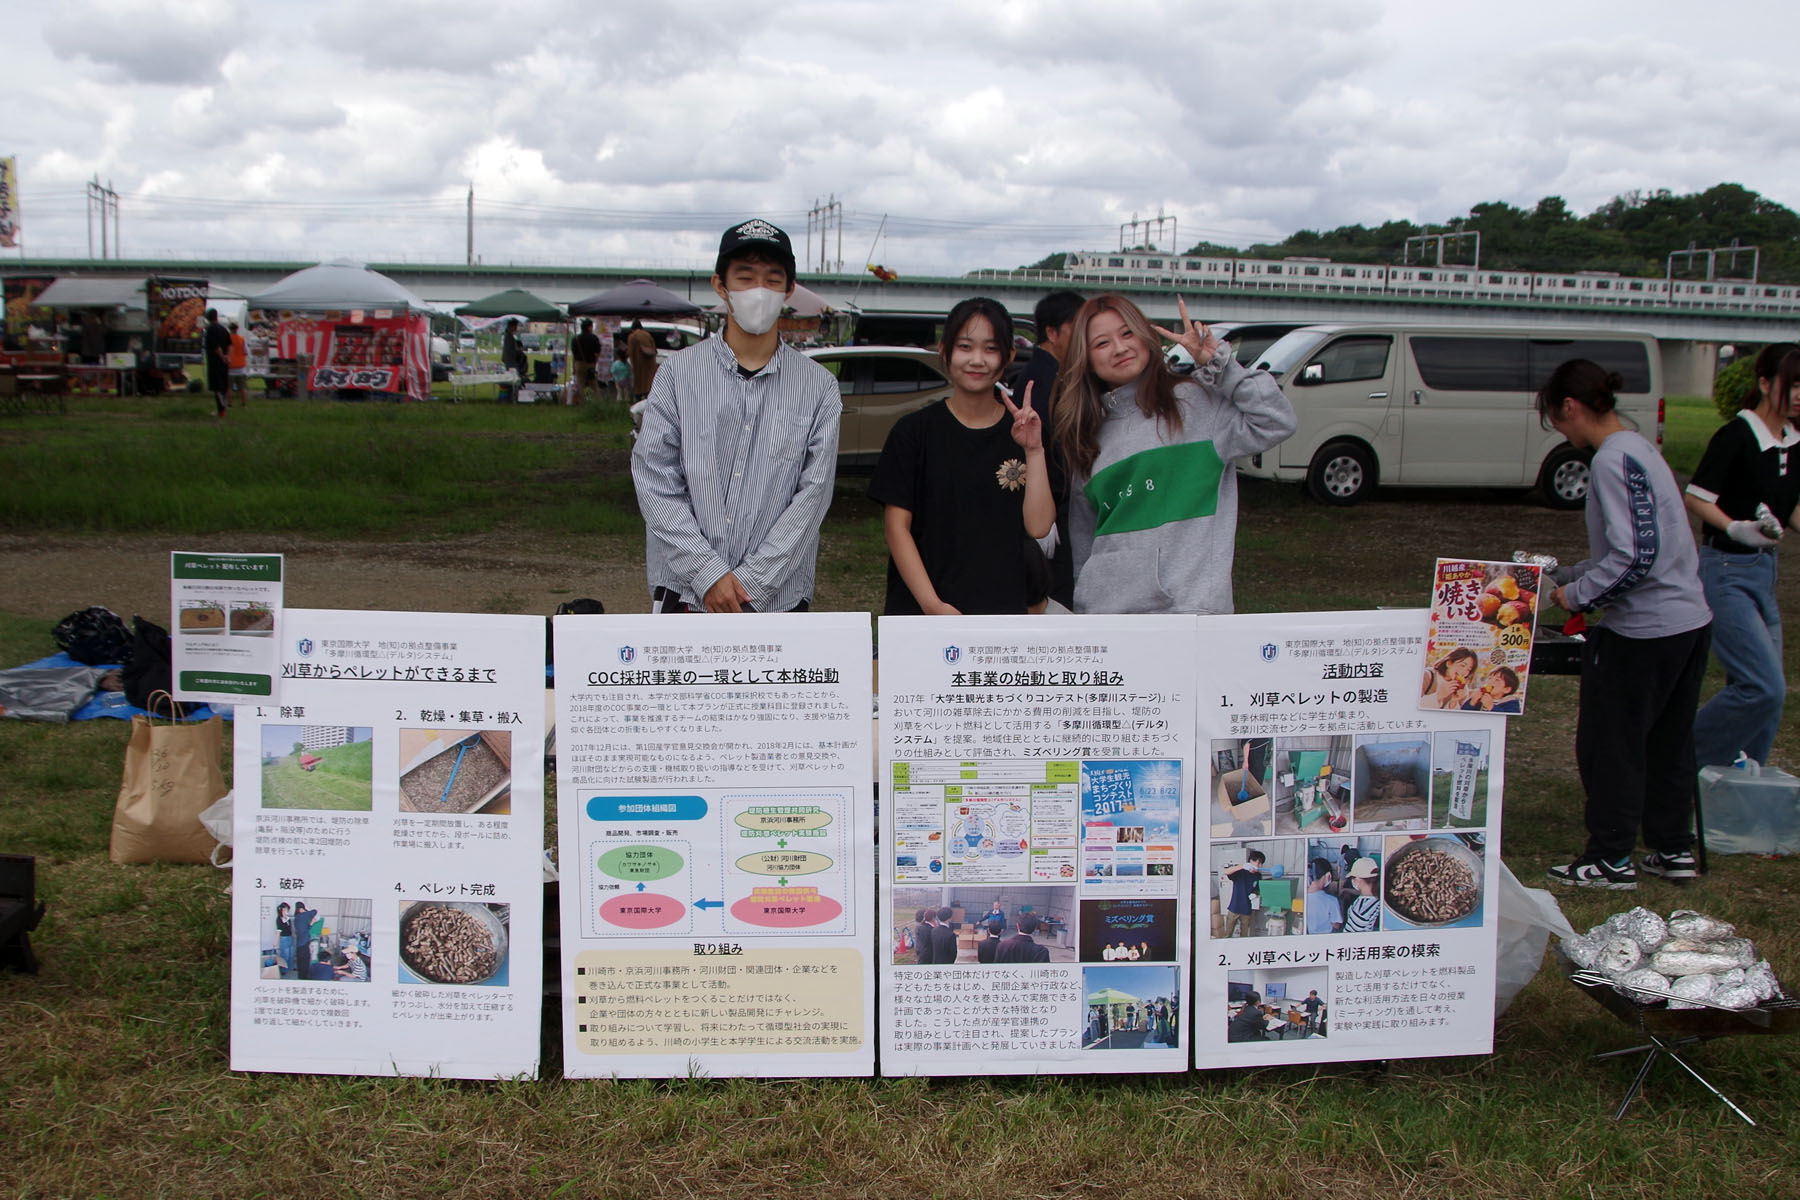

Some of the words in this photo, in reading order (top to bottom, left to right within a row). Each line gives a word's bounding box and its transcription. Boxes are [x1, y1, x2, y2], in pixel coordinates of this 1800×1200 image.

[1623, 548, 1656, 589] THREE
[1439, 580, 1480, 606] 焼き
[1447, 602, 1481, 620] いも
[321, 640, 370, 650] 東京国際大学
[643, 646, 693, 654] 東京国際大学
[968, 646, 1018, 655] 東京国際大学
[1285, 640, 1334, 648] 東京国際大学
[282, 663, 497, 682] 刈草からペレットができるまで
[588, 668, 839, 686] COC採択事業の一環として本格始動
[1322, 663, 1384, 679] 活動内容
[951, 670, 1124, 687] 本事業の始動と取り組み
[1221, 695, 1233, 707] 1.
[1250, 688, 1388, 706] 刈草ペレットの製造
[256, 706, 268, 718] 1.
[280, 706, 305, 719] 除草
[396, 710, 407, 722] 2.
[420, 709, 522, 724] 乾燥・集草・搬入
[894, 706, 1161, 718] おいて河川の雑草除去にかかる費用の削減を目指し、堤防の
[1094, 790, 1132, 802] コンテスト
[1095, 800, 1122, 814] 2017
[625, 851, 653, 859] 協力団体
[256, 878, 267, 889] 3.
[280, 877, 305, 890] 破砕
[394, 882, 406, 893] 4.
[419, 882, 496, 896] ペレット完成
[1104, 914, 1156, 923] ミズベリング賞
[694, 944, 743, 956] 取り組み
[1218, 954, 1232, 966] 2.
[1248, 943, 1441, 965] 刈草ペレット利活用案の模索
[894, 970, 1068, 980] 特定の企業や団体だけでなく、川崎市の
[588, 980, 732, 990] 巻き込んで正式な事業として活動。
[1336, 980, 1451, 993] として活用するだけでなく、
[894, 993, 1077, 1004] 様々な立場の人々を巻き込んで実施できる
[590, 1008, 826, 1019] 企業や団体の方々とともに新しい製品開発にチャレンジ。
[894, 1005, 1057, 1016] 計画であったことが大きな特徴となり
[1334, 1018, 1449, 1032] 実験や実践に取り組みます。
